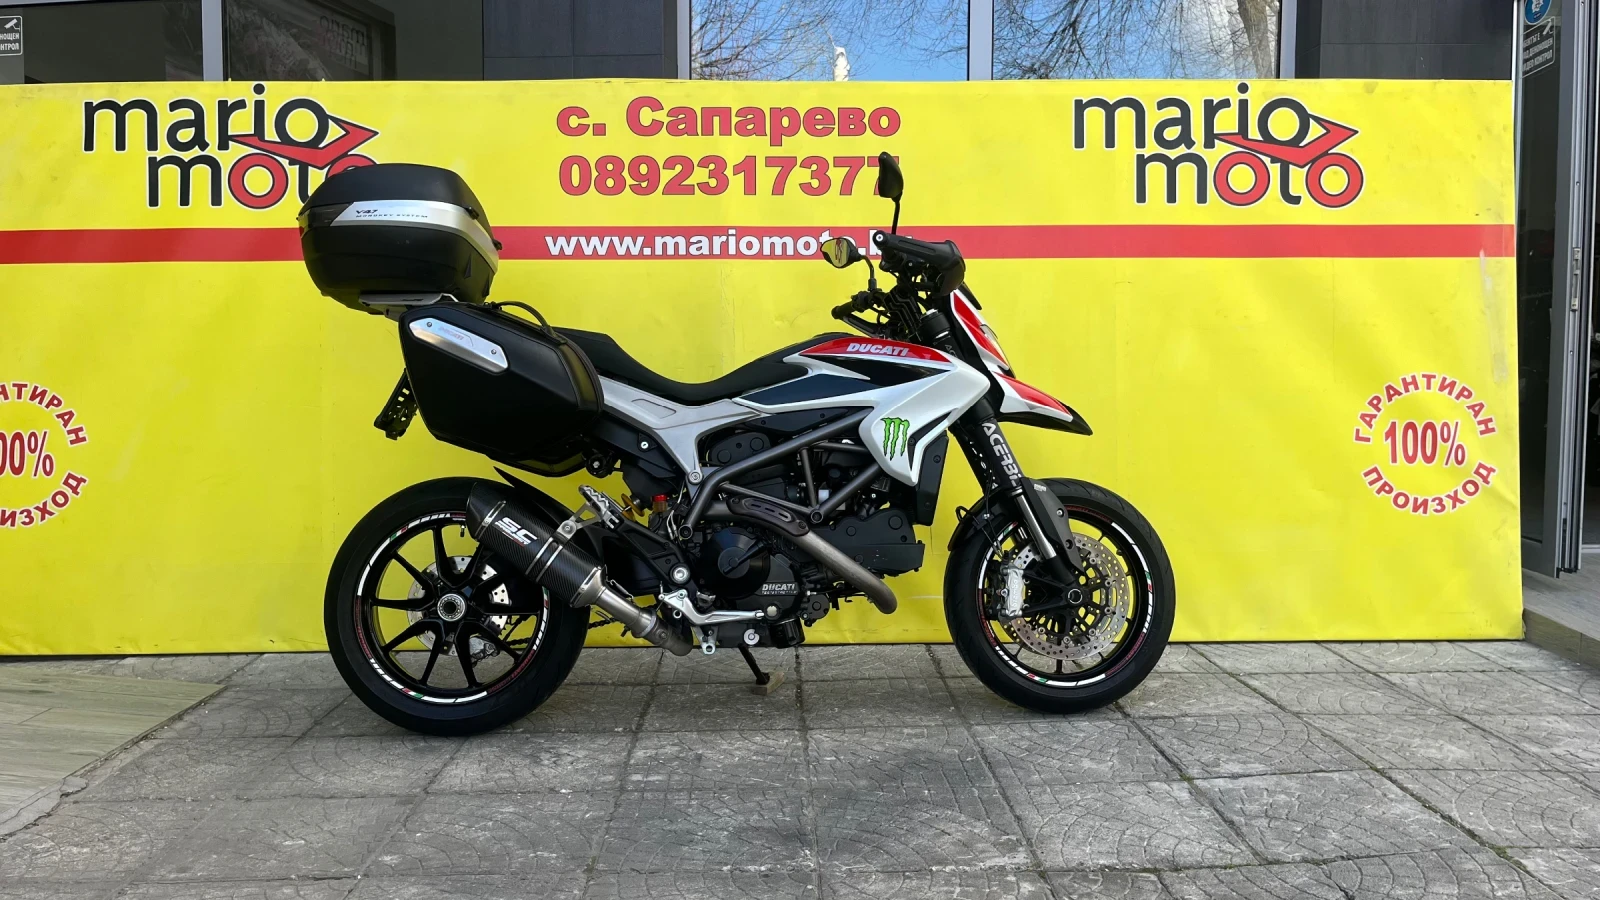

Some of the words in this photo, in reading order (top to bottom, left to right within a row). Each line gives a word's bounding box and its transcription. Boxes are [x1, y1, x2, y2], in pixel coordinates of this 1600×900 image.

[84, 83, 329, 152] mario
[557, 106, 606, 137] с.
[626, 95, 901, 147] Сапарево
[1074, 82, 1310, 150] mario
[1136, 150, 1364, 208] moto
[544, 228, 913, 257] www.mariomot.
[846, 342, 909, 357] DUCATI
[1354, 373, 1496, 443] ГАРАНТИРАН
[1384, 421, 1466, 466] 100%
[1362, 462, 1496, 515] ПРОИЗХОД
[762, 583, 796, 591] DUCATI
